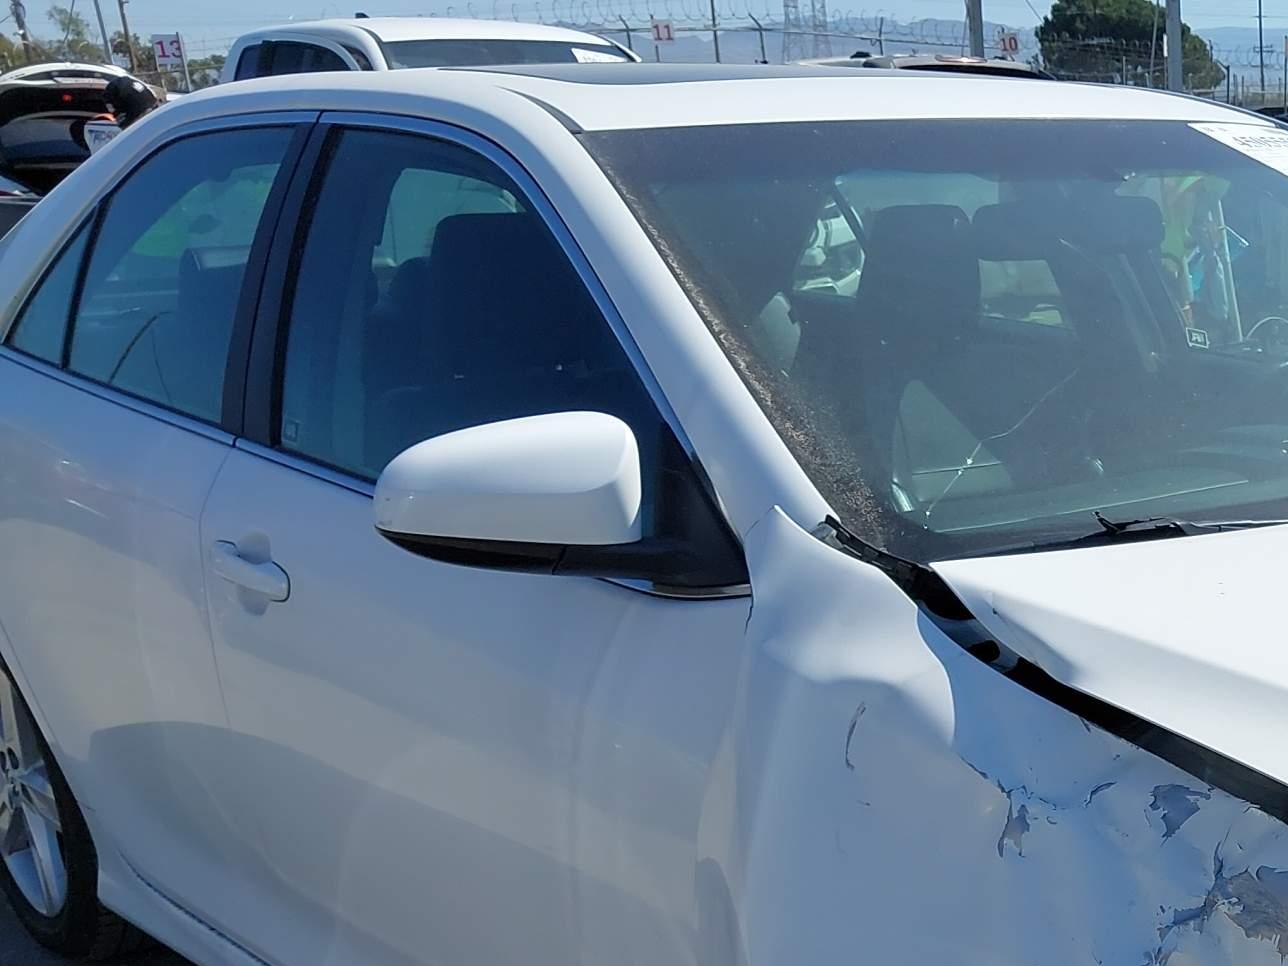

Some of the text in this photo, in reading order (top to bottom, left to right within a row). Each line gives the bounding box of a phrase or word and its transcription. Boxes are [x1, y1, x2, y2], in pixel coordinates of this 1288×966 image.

[652, 24, 674, 41] 11
[154, 39, 182, 58] 13
[1000, 36, 1018, 51] 10
